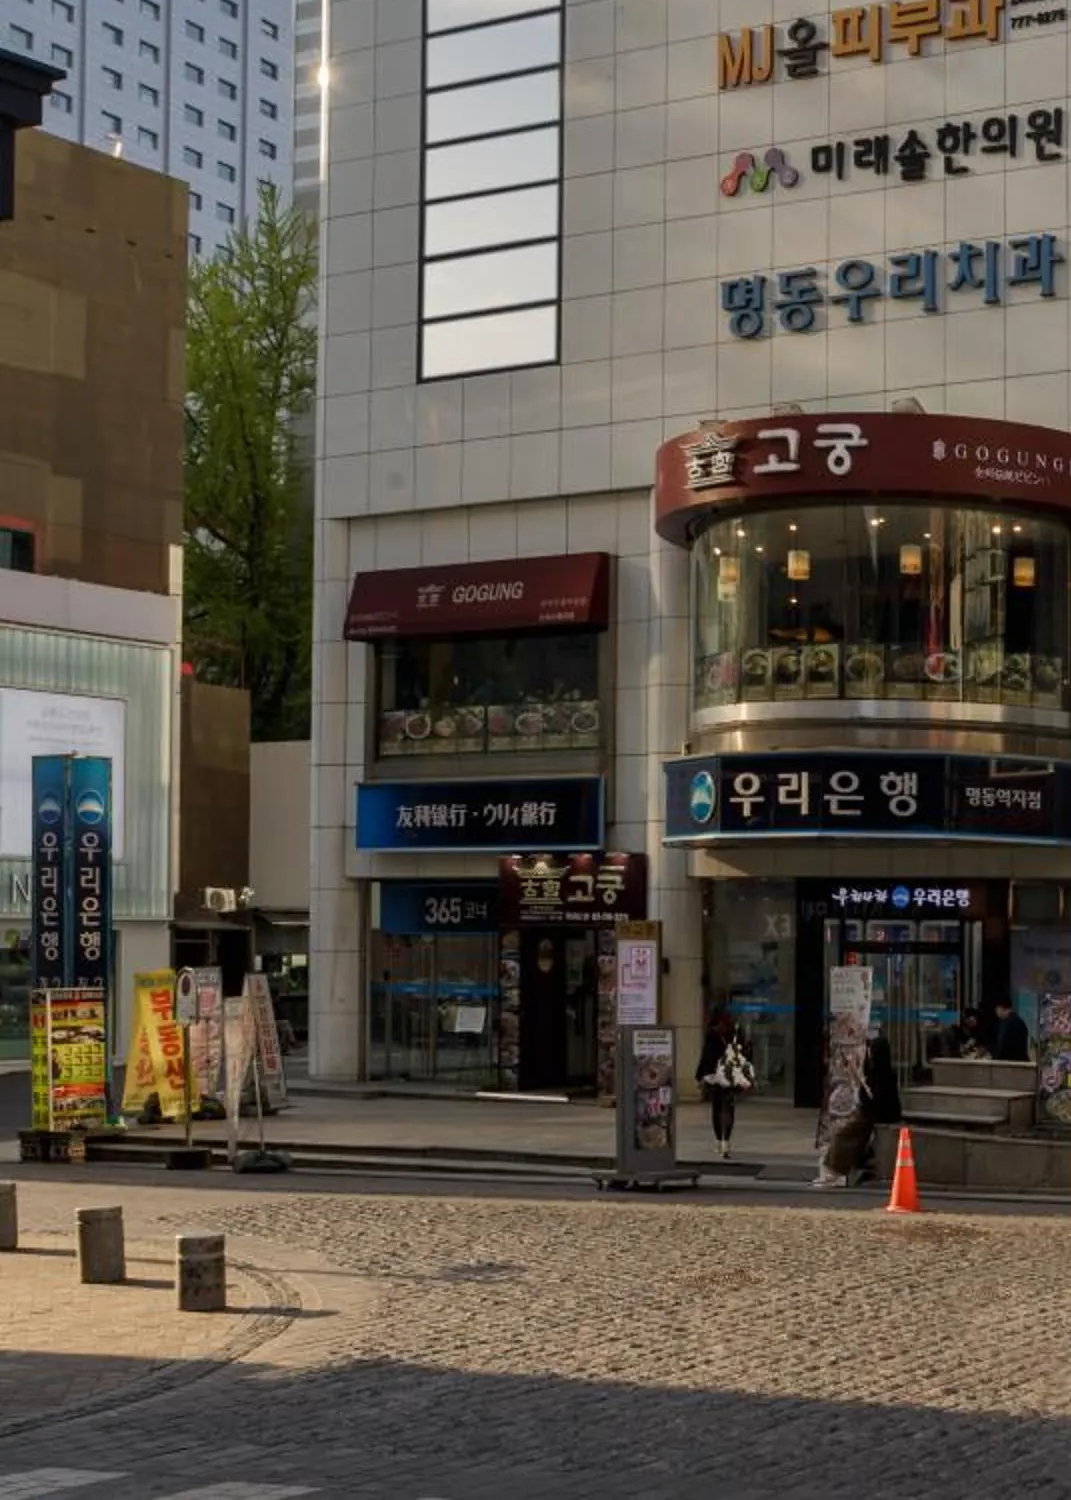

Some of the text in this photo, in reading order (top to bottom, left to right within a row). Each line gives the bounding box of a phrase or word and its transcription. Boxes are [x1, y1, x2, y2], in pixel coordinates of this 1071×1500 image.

[811, 106, 1066, 181] 미래솔한의원
[720, 232, 1066, 339] 명동우리치과
[753, 423, 868, 476] 고궁
[955, 442, 1064, 473] GOGUNG
[452, 581, 524, 604] GOGUNG
[729, 771, 919, 817] 우리은행
[40, 831, 60, 961] 우리은행
[78, 831, 103, 961] 우리은행
[425, 898, 488, 923] 365 코너
[567, 873, 626, 906] 고궁
[912, 887, 970, 909] 우리은행
